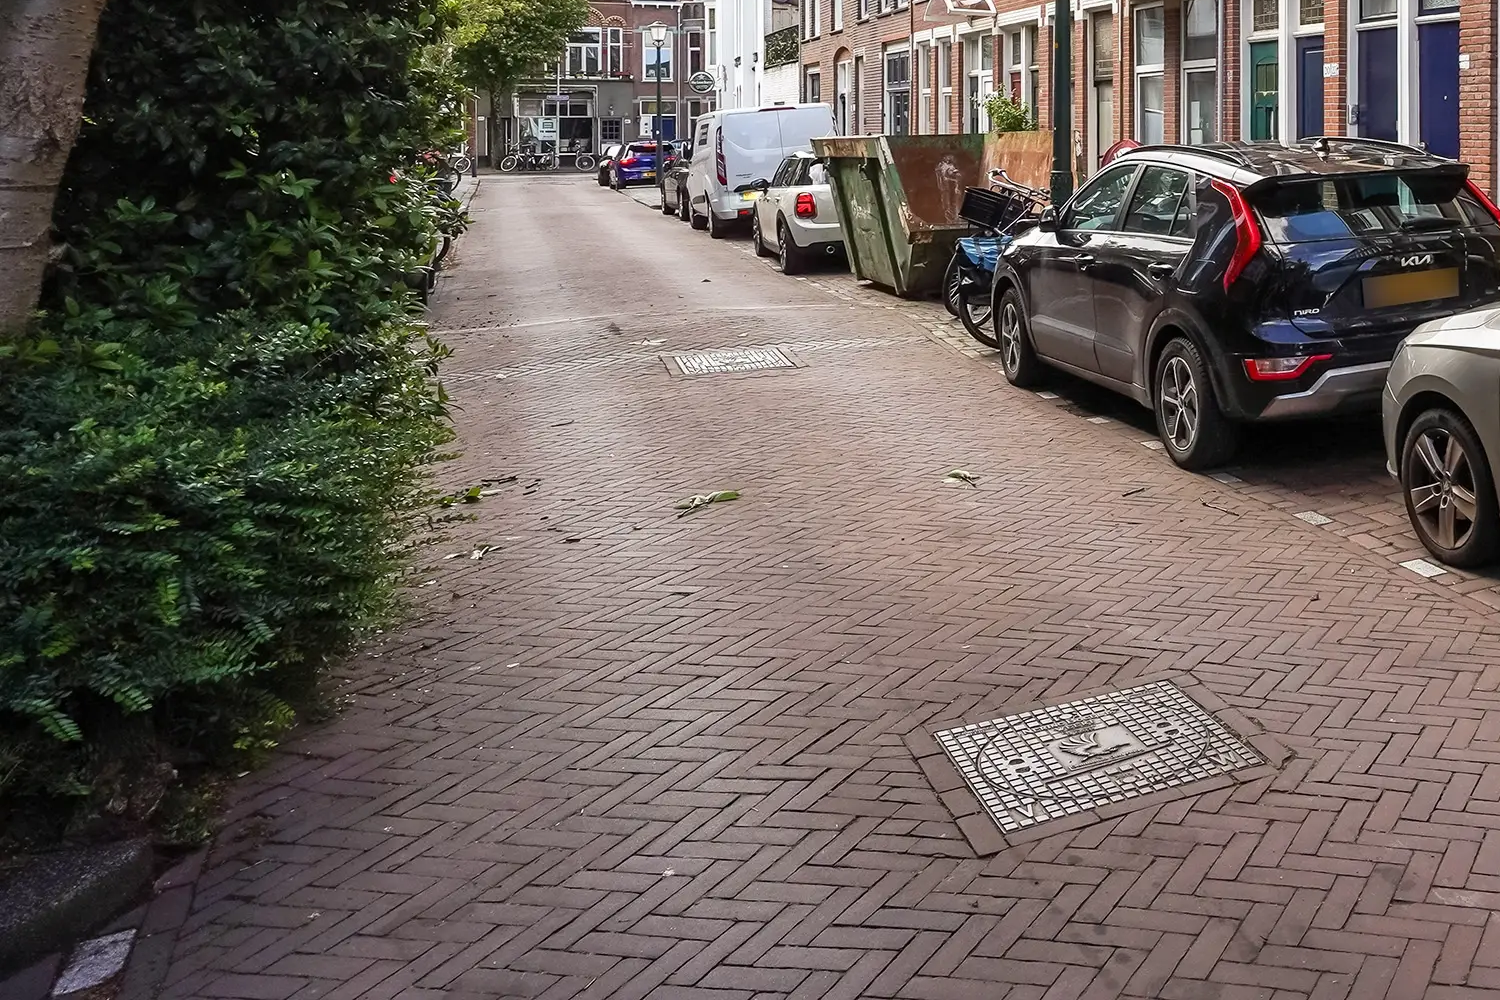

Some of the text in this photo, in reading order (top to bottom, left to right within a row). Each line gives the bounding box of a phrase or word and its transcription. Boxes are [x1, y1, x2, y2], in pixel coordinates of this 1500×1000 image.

[1400, 254, 1431, 267] KIA
[1293, 308, 1320, 316] NIRO
[1206, 751, 1239, 766] W
[1015, 803, 1034, 818] V
